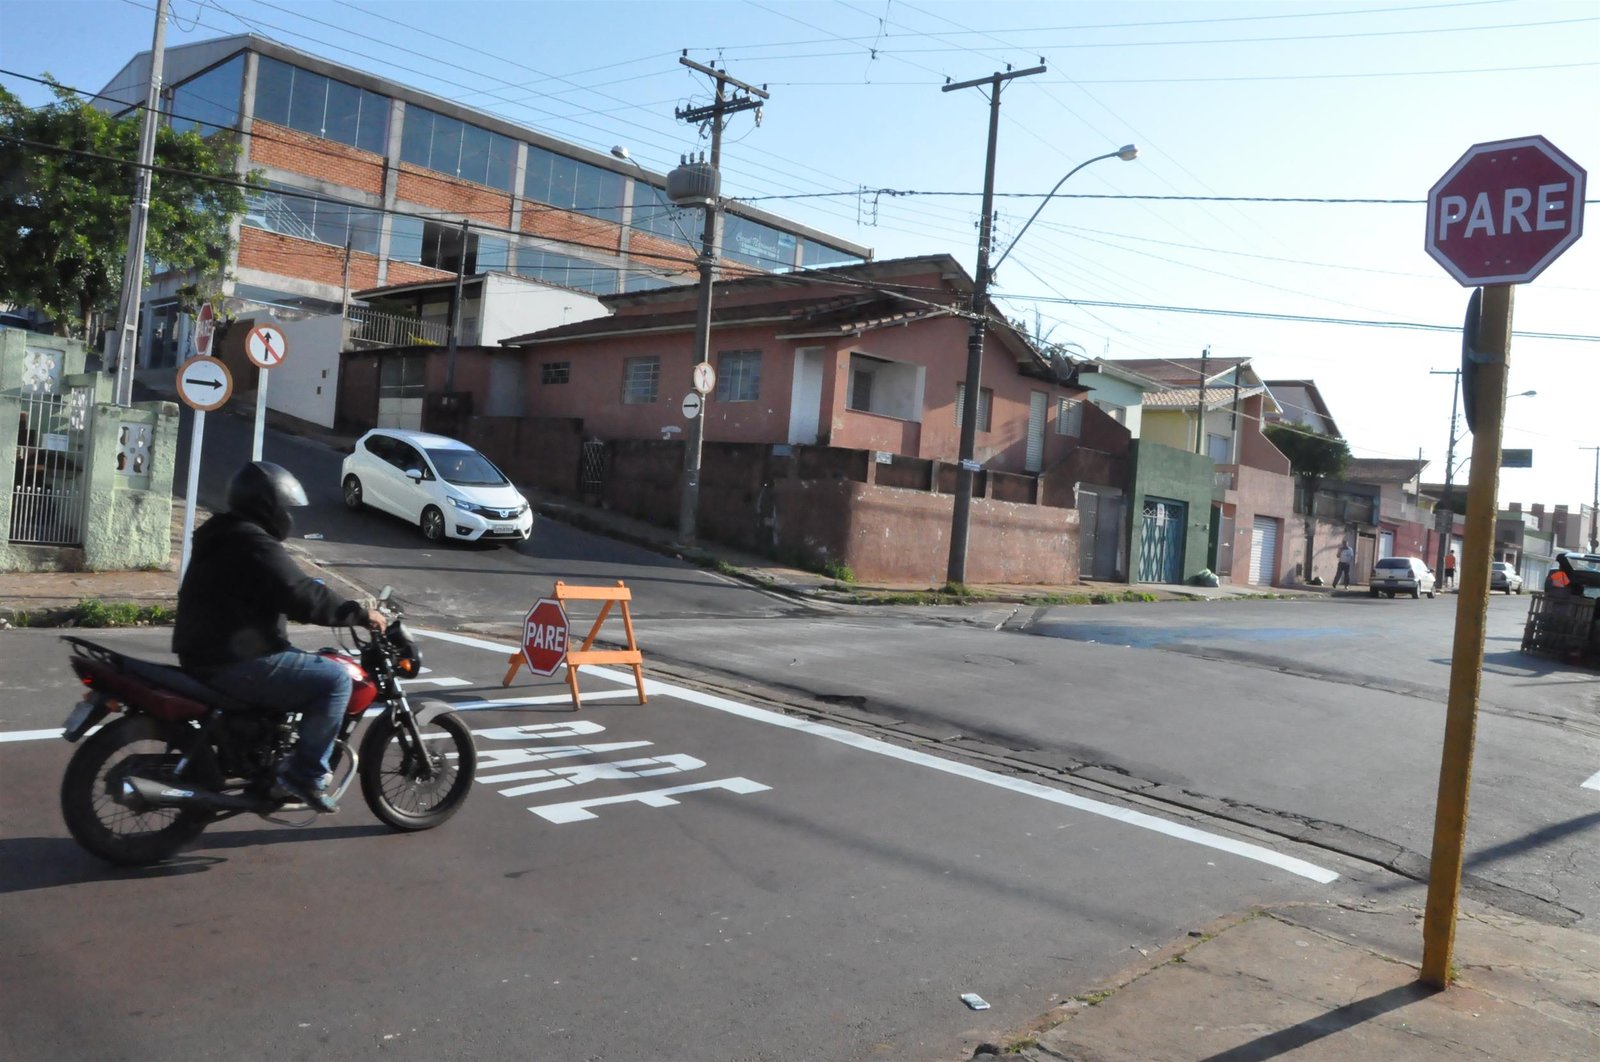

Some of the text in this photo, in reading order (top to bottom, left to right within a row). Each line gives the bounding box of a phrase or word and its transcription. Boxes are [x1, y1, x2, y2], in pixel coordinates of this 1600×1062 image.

[1439, 182, 1568, 241] PARE
[526, 621, 566, 652] PARE
[390, 720, 774, 825] PARE
